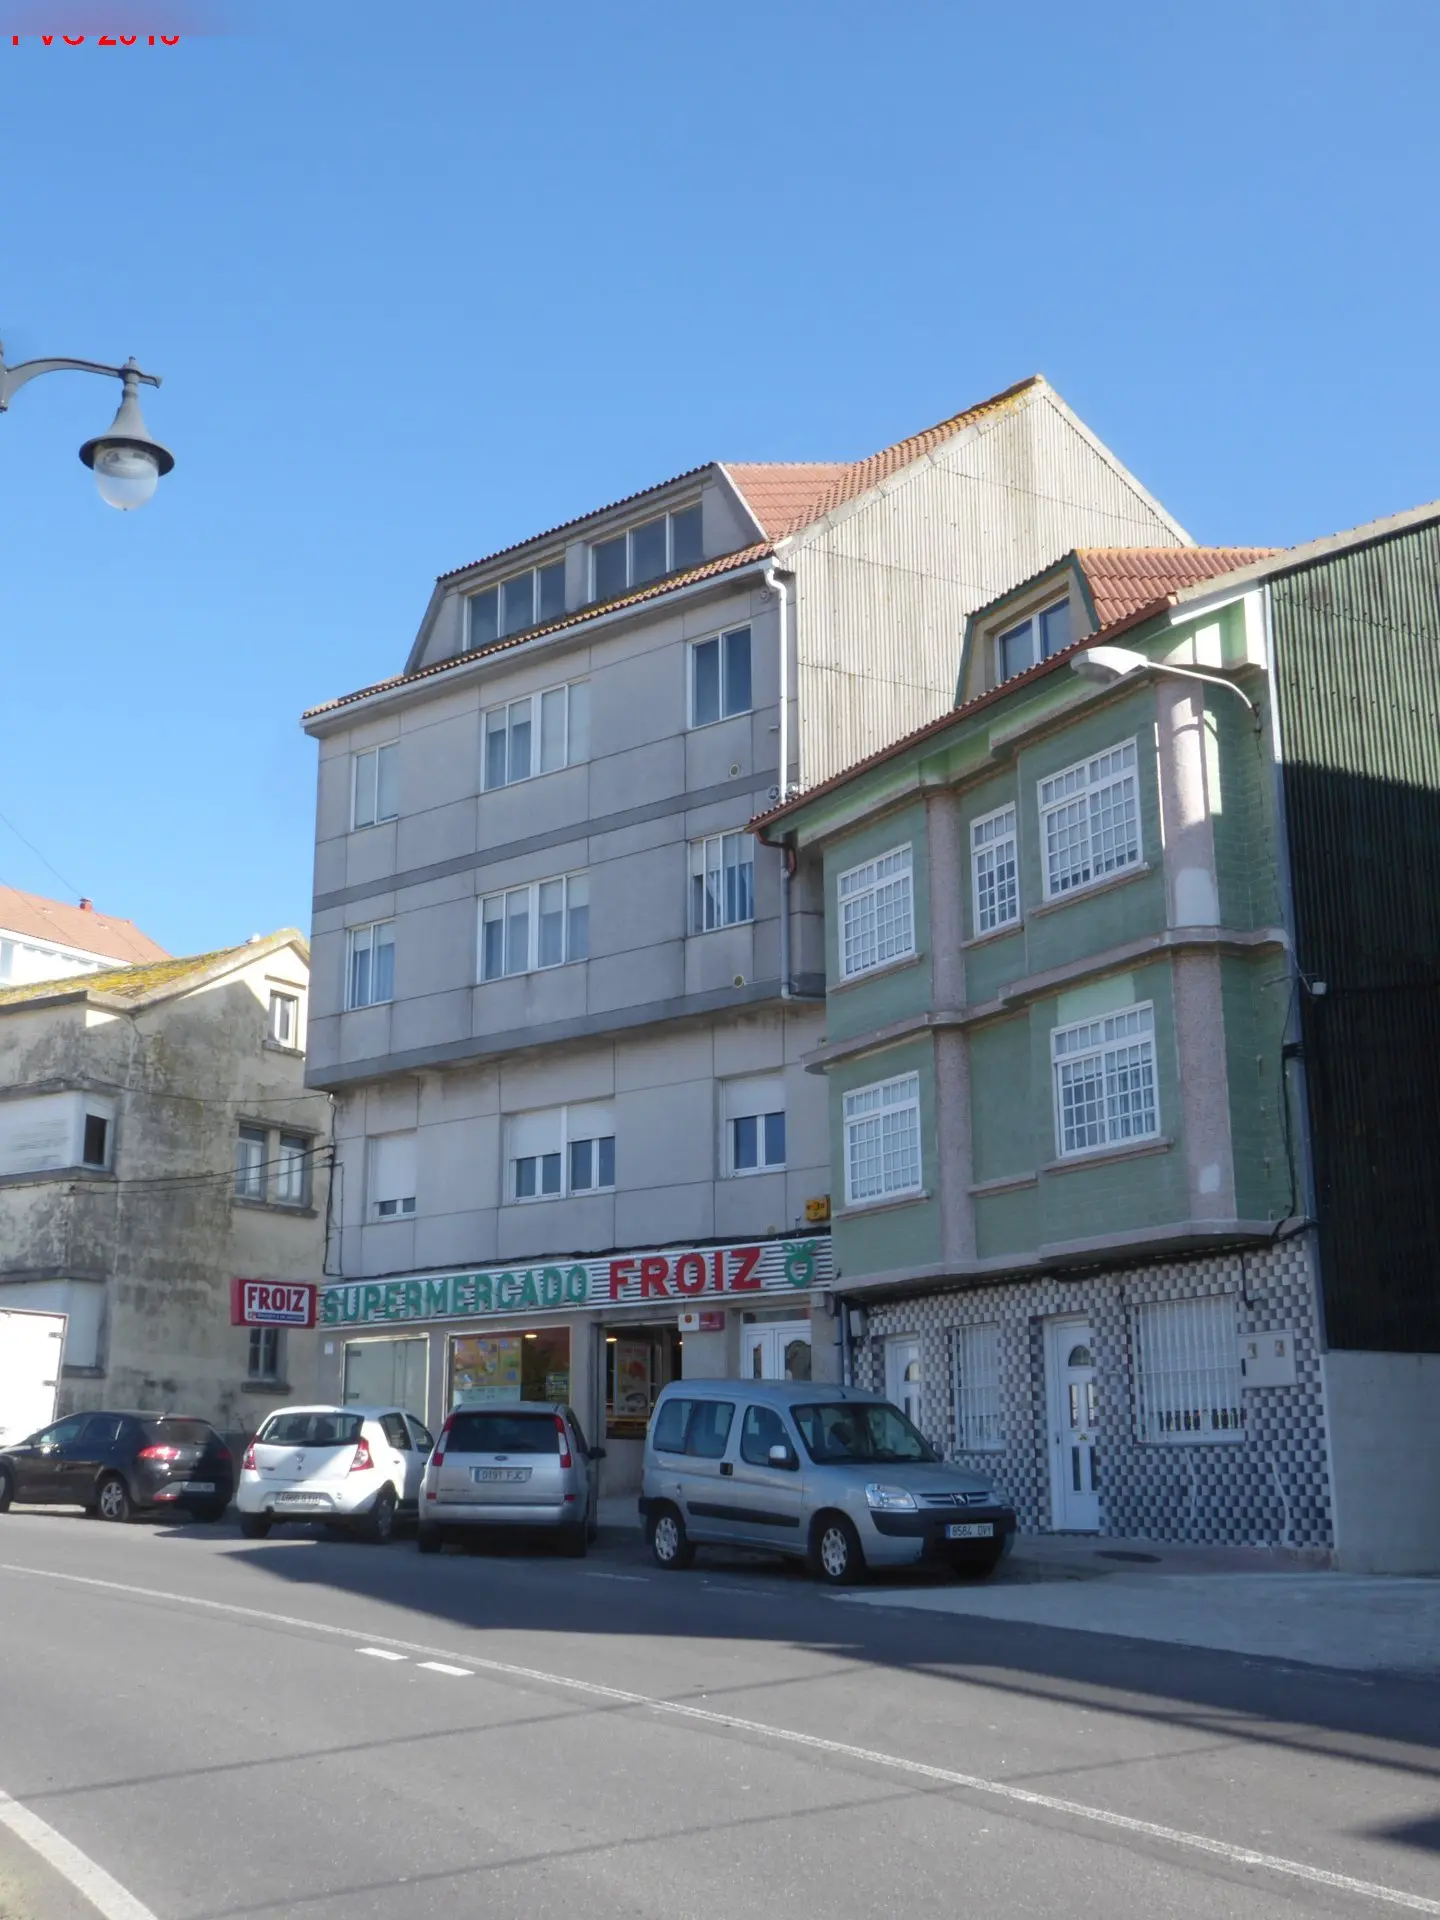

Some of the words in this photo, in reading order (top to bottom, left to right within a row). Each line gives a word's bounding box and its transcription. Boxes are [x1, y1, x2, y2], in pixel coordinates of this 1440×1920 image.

[247, 1286, 305, 1312] FROIZ
[324, 1265, 588, 1323] SUPERMERCADO
[609, 1248, 761, 1300] FROIZ
